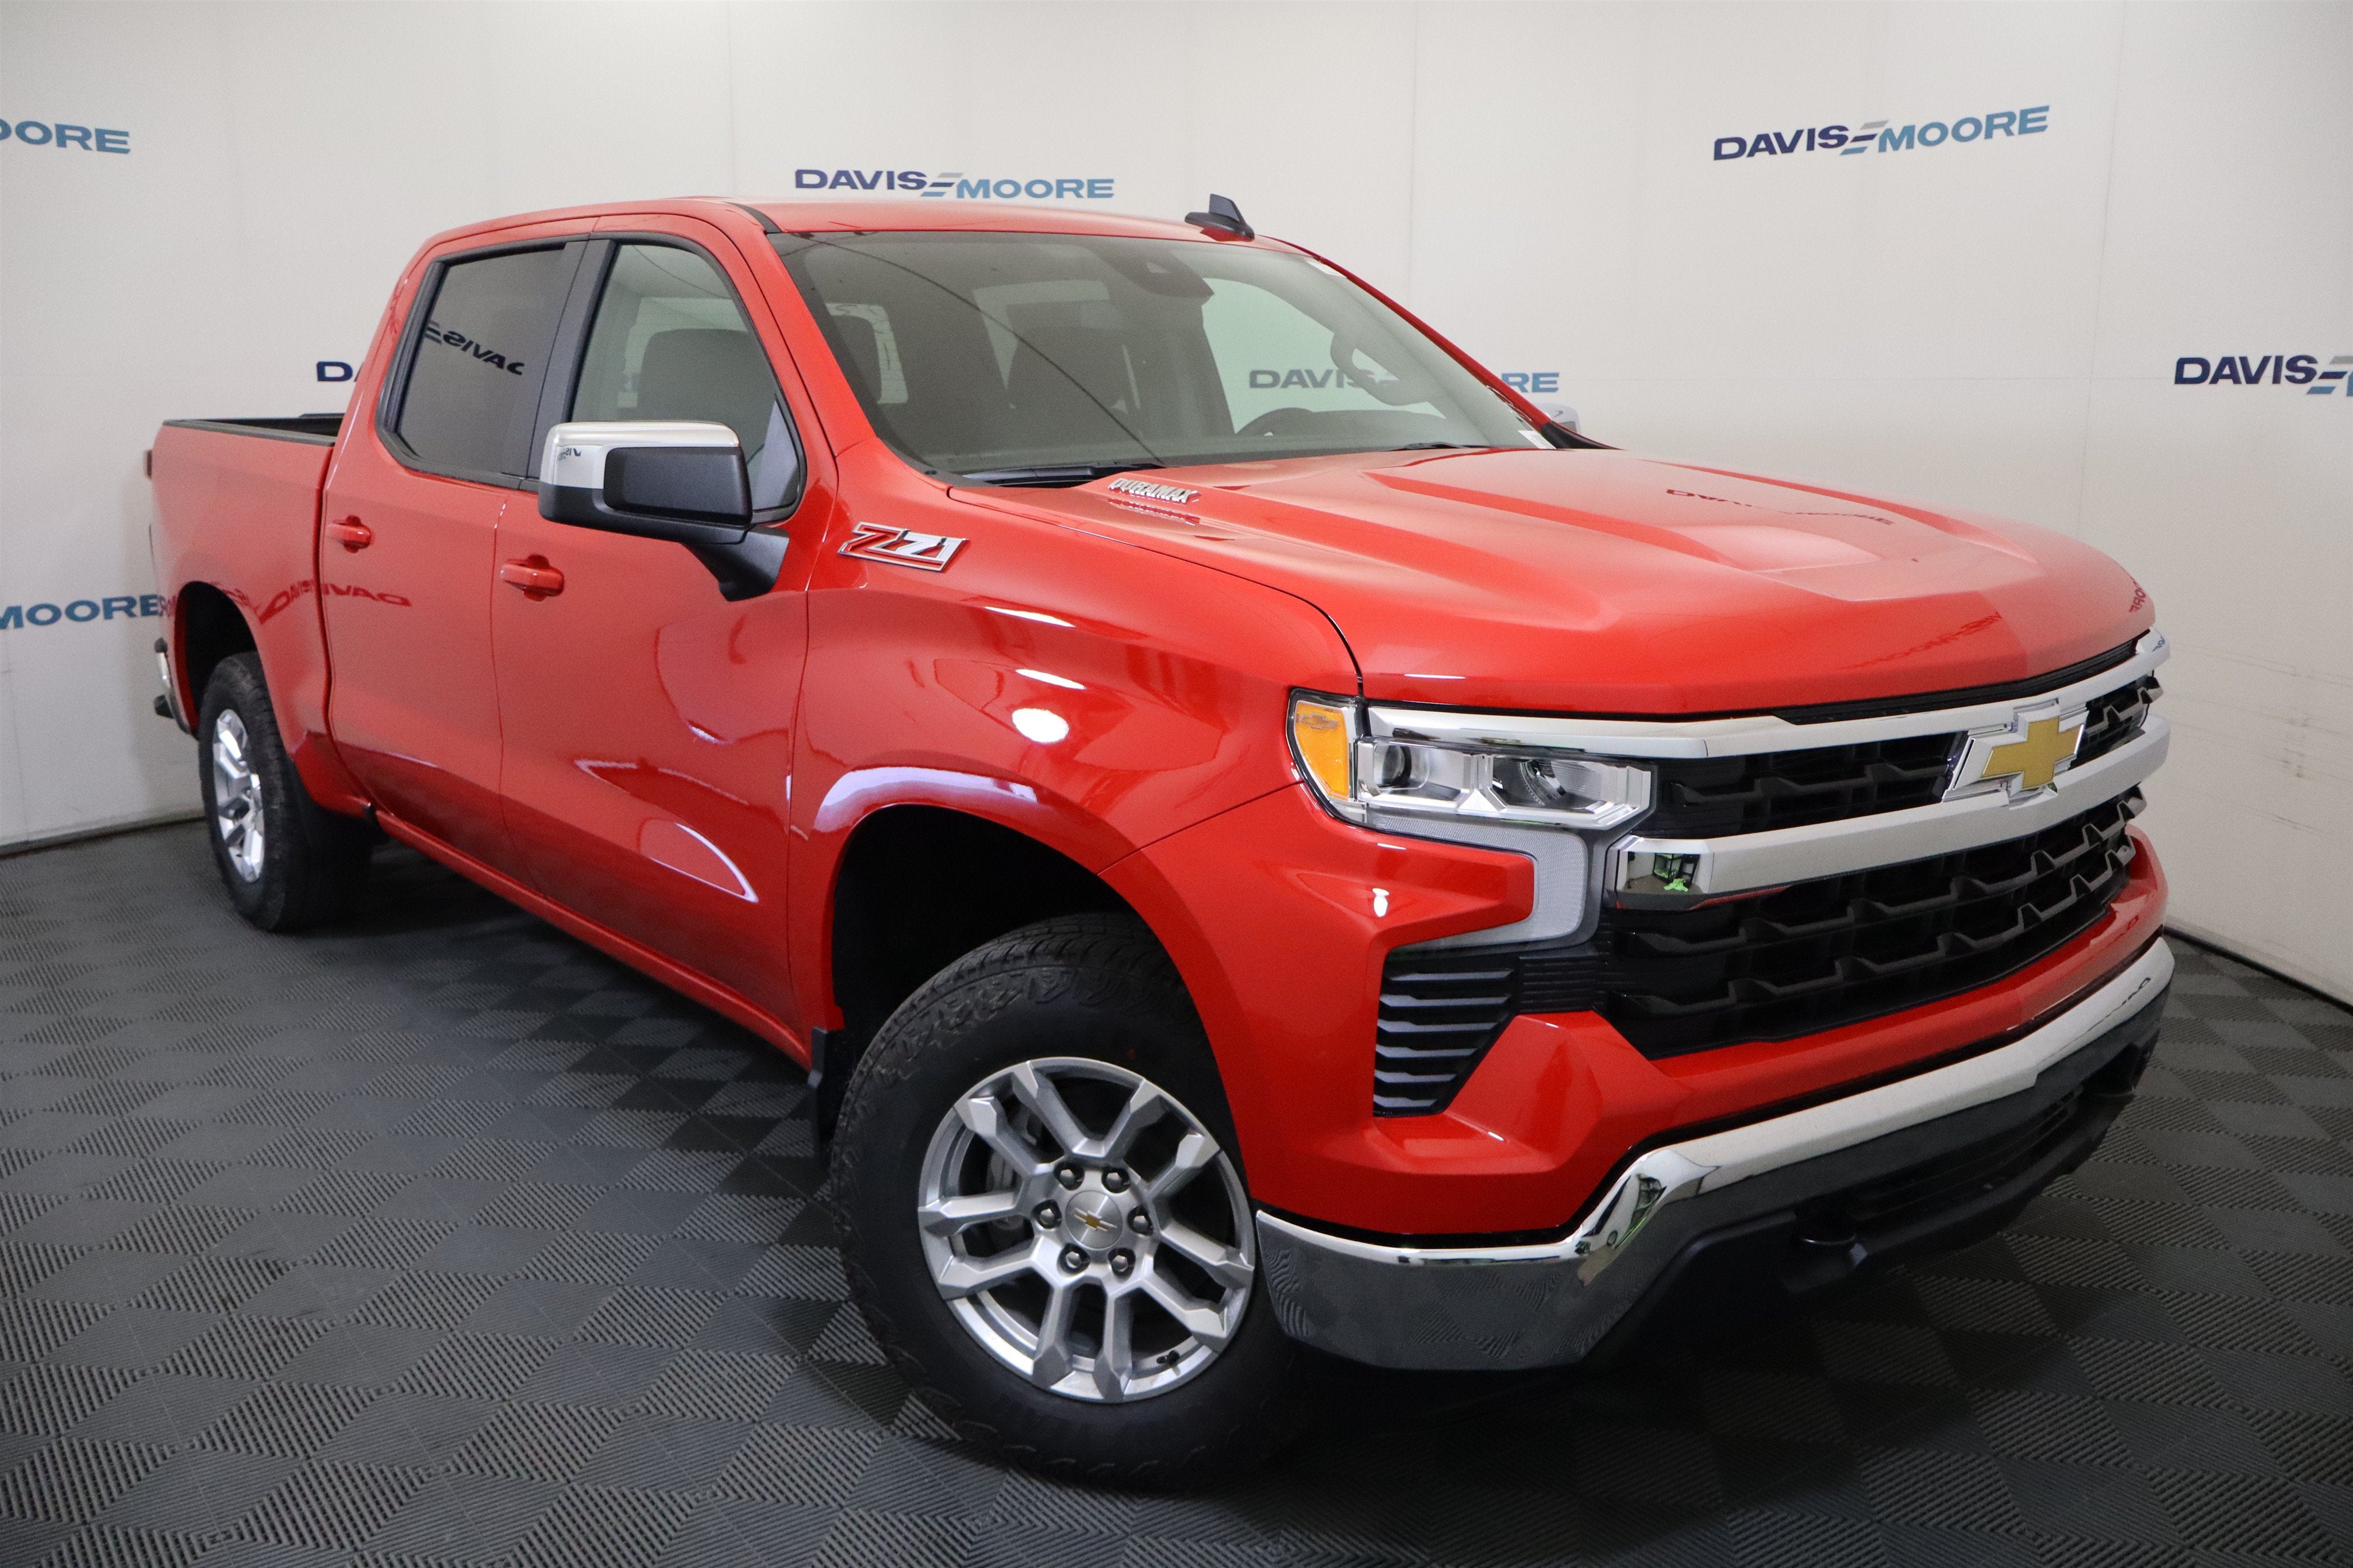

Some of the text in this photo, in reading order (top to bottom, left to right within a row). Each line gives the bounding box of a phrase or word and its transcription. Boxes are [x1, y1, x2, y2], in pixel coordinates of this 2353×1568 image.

[1714, 105, 2050, 161] DAVIS MOORE
[795, 169, 1114, 199] DAVIS MOORE
[2174, 355, 2319, 384] DAVIS
[1108, 477, 1201, 503] DURAMAX
[838, 521, 969, 572] Z71
